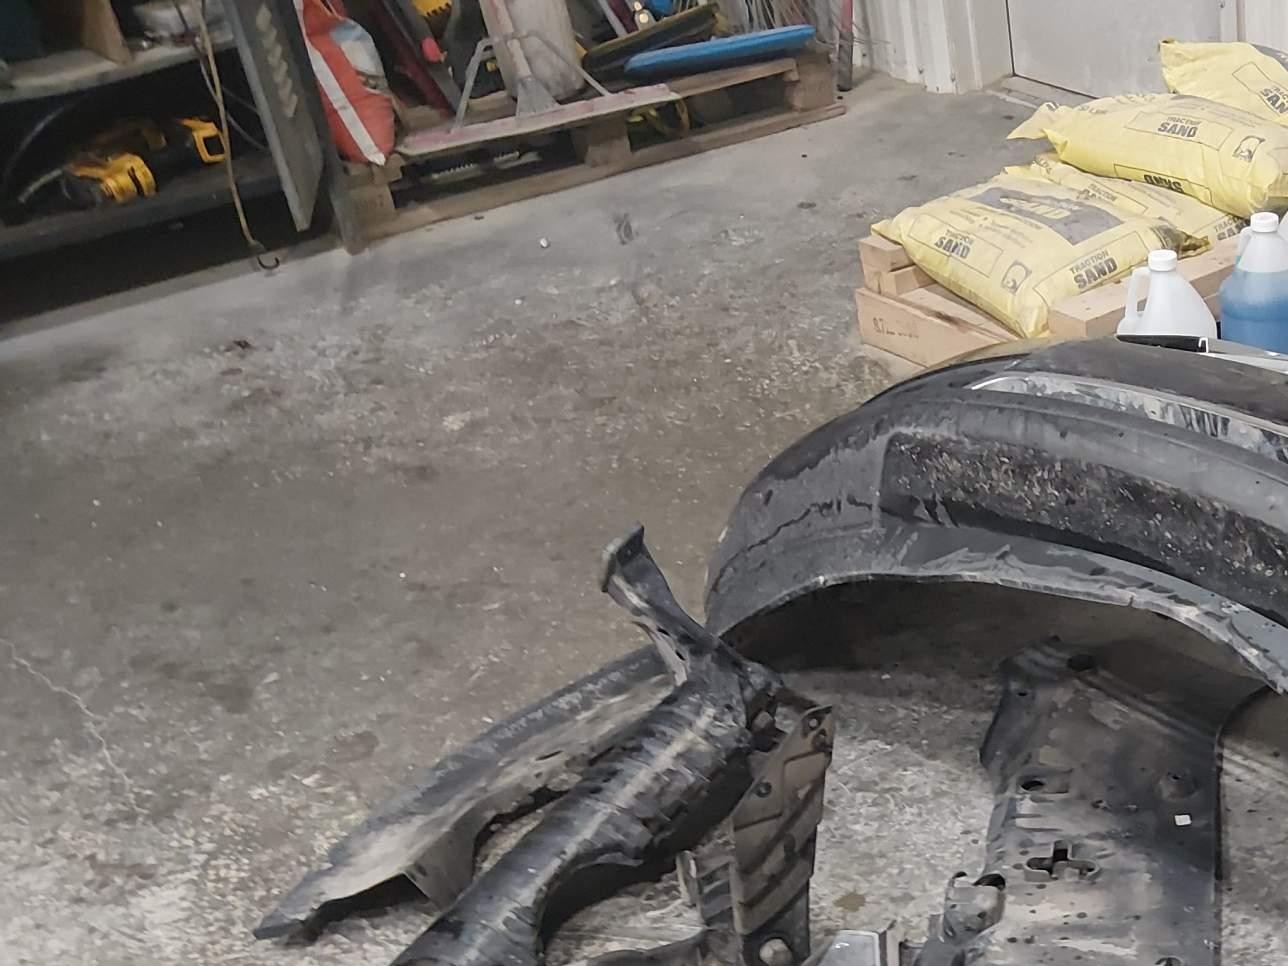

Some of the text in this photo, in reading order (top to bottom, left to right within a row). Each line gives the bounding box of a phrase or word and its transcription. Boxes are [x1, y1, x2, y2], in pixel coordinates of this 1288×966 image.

[1157, 121, 1198, 138] SAND
[934, 236, 970, 259] SAND
[1069, 249, 1109, 275] TRACTION
[1073, 257, 1118, 289] SAND
